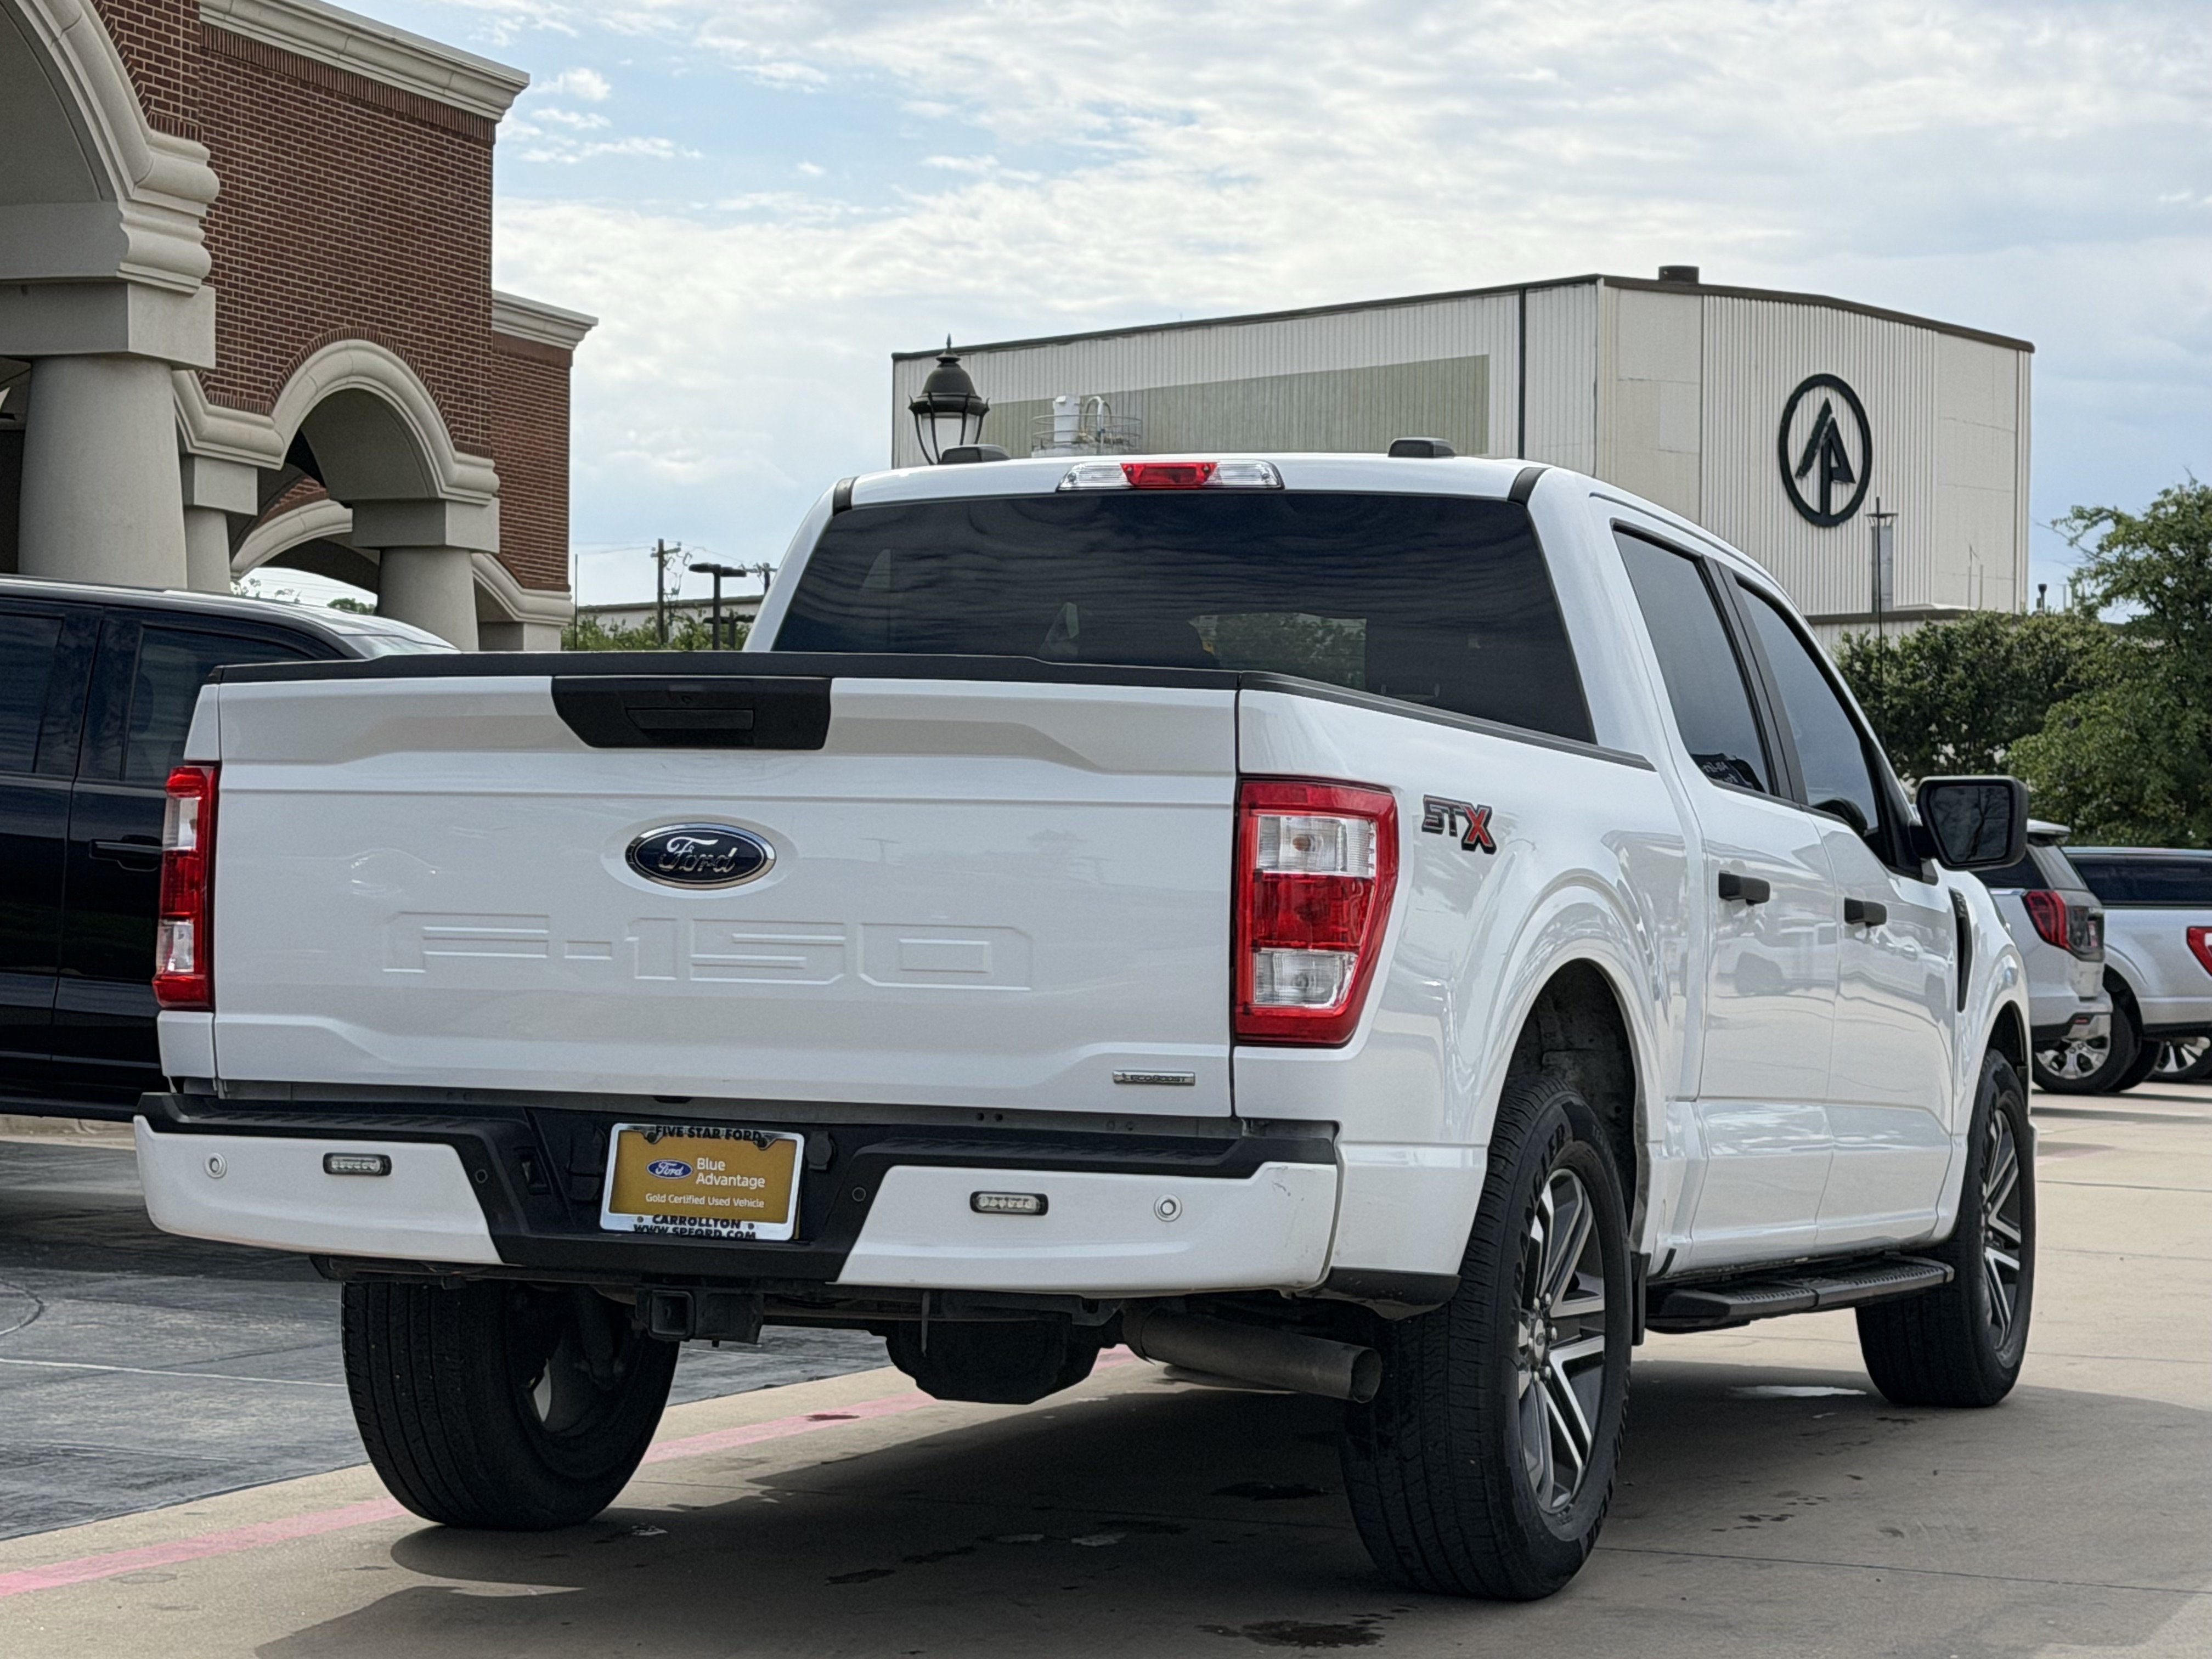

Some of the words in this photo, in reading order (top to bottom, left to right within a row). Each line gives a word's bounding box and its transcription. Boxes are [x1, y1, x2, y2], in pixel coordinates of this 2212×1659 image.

[1421, 794, 1497, 855] STX
[658, 836, 738, 873] Ford
[382, 911, 1032, 991] F-150
[655, 1125, 684, 1138] FIVE
[687, 1126, 721, 1139] STAR
[654, 1161, 684, 1177] Ford
[697, 1157, 726, 1171] Blue
[696, 1172, 765, 1190] Advantage
[645, 1193, 666, 1203] Gold
[668, 1193, 705, 1205] Certified
[708, 1196, 730, 1206] Used
[733, 1198, 765, 1208] Vehicle
[652, 1214, 741, 1229] CARROLLTON
